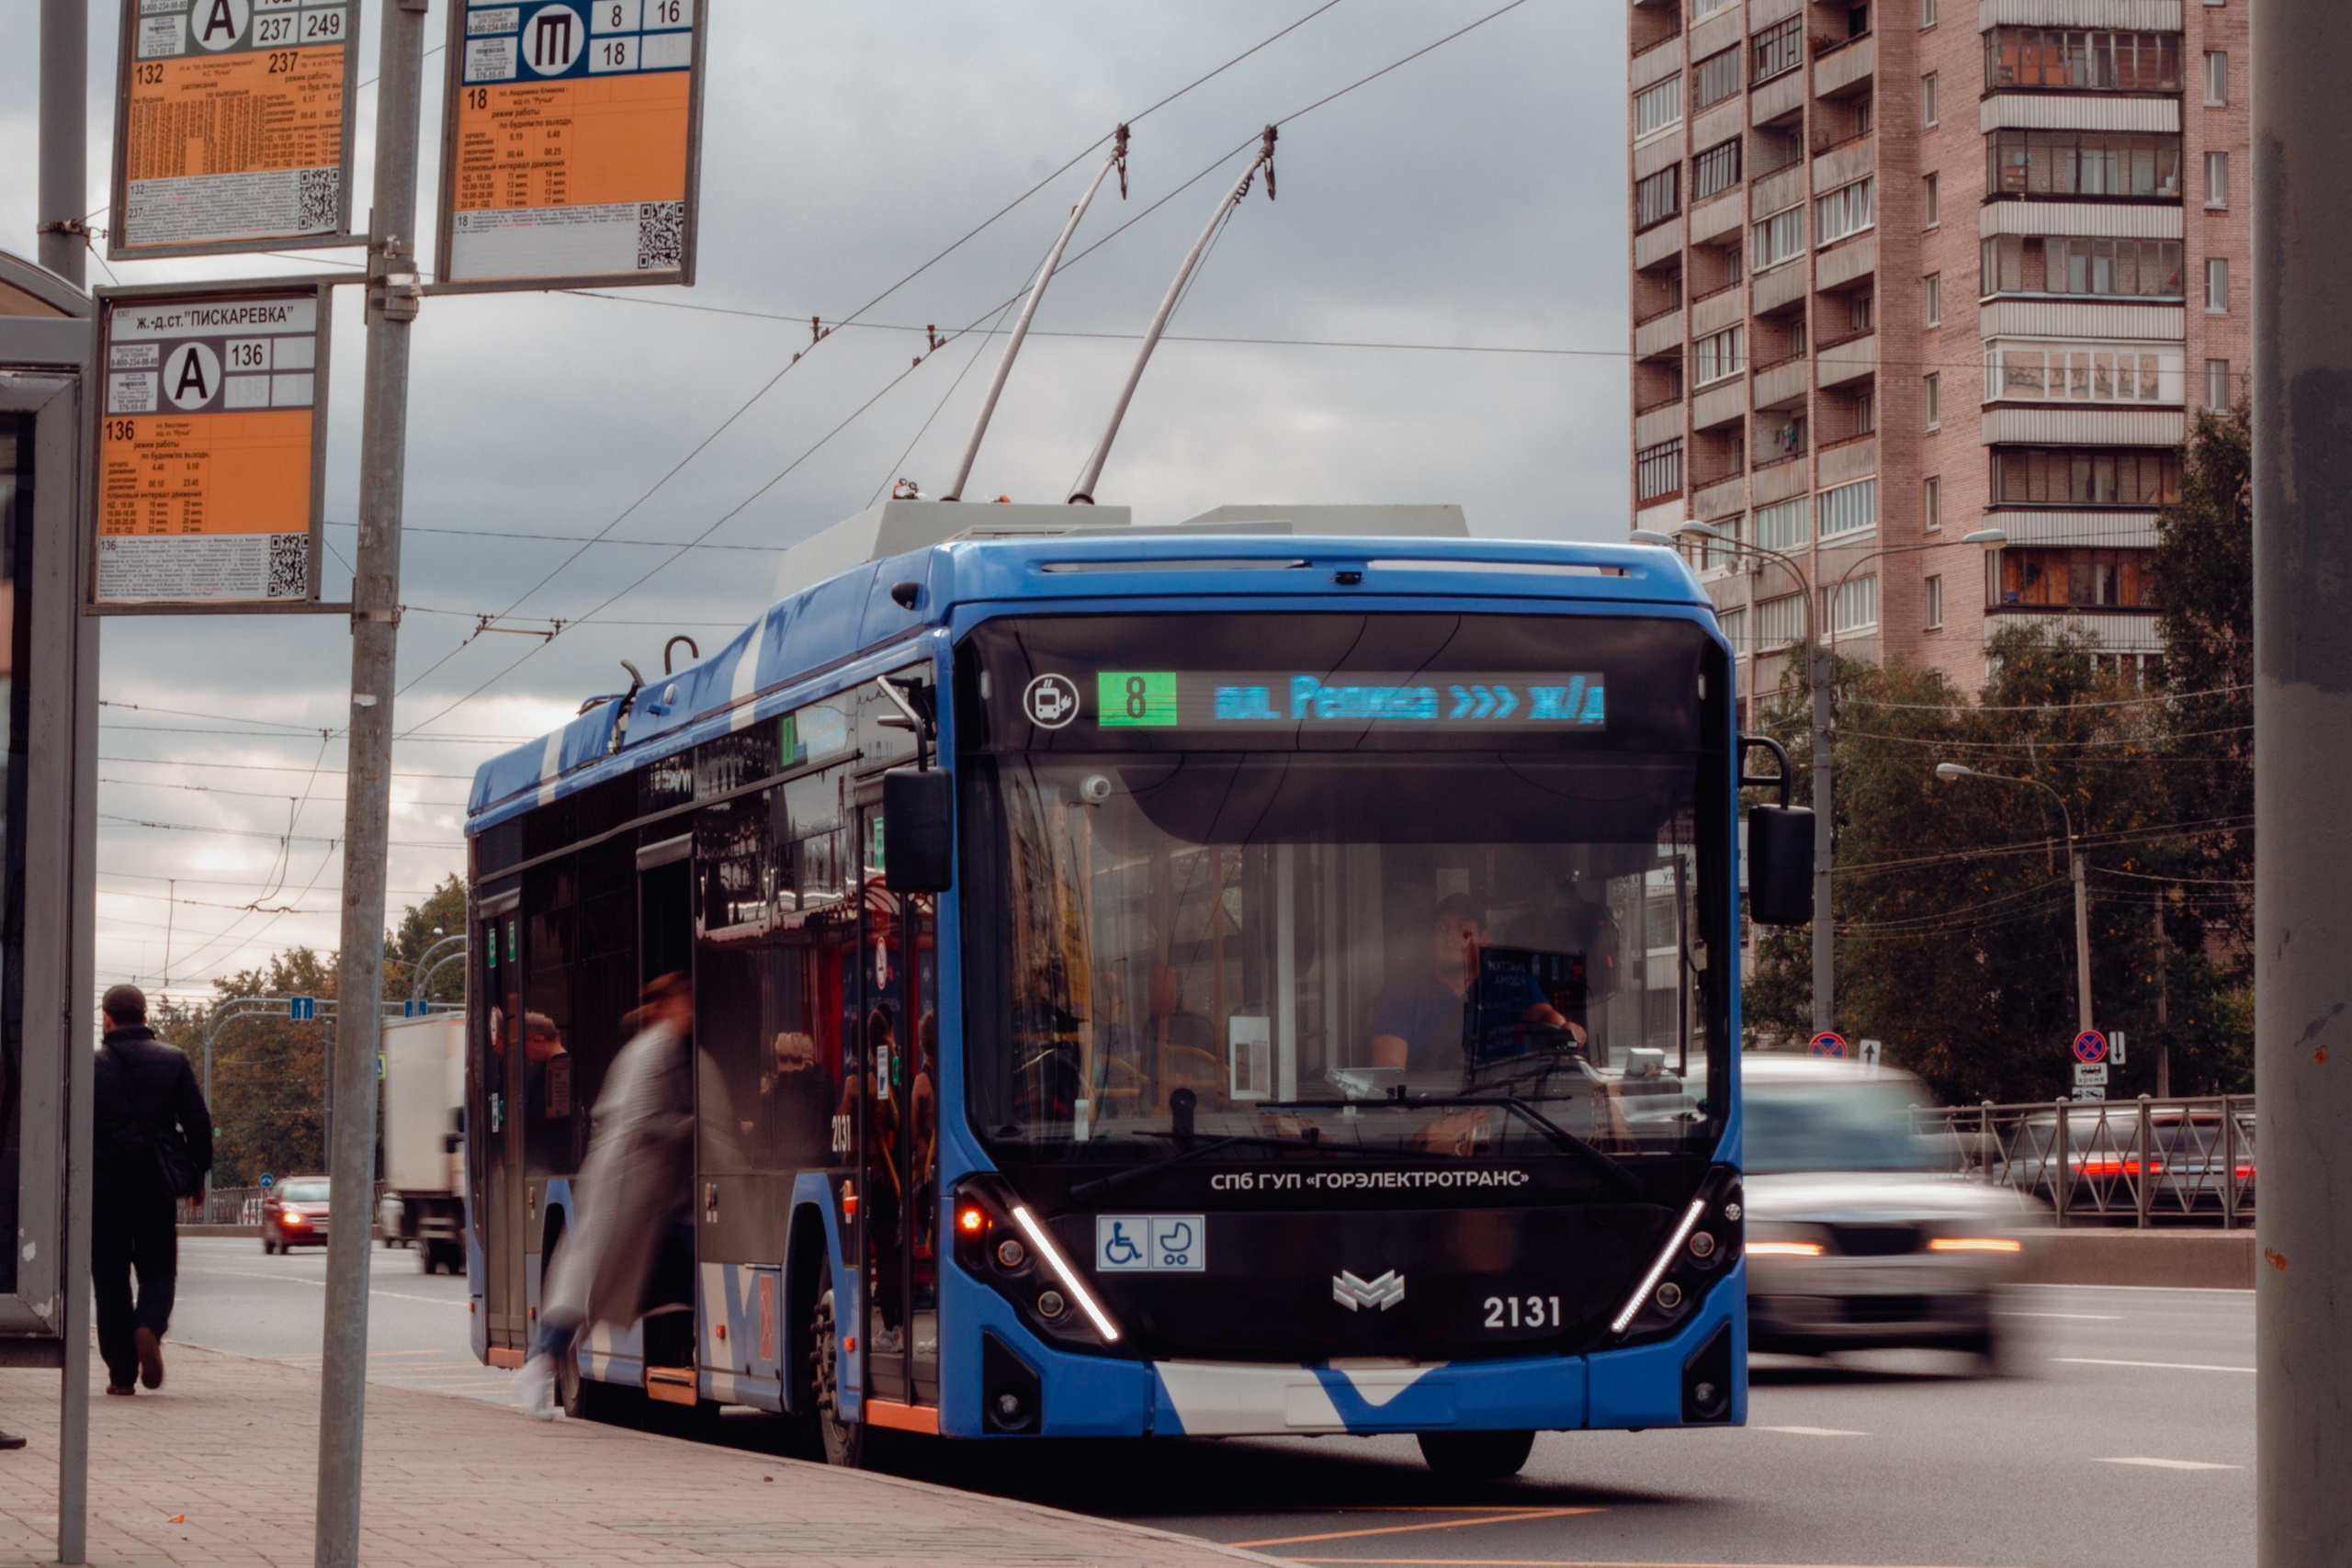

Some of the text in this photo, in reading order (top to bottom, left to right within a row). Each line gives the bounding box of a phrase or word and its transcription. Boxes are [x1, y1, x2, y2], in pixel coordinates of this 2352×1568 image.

[611, 0, 680, 28] 8 16
[260, 13, 339, 41] 237 249
[269, 52, 299, 73] 237
[603, 42, 625, 66] 18
[137, 63, 164, 85] 132
[285, 72, 331, 84] режим работы
[181, 82, 218, 91] расписание
[468, 88, 487, 110] 18
[492, 107, 540, 119] режим работы
[507, 148, 561, 158] 00.44 00.25
[462, 164, 496, 172] плановый
[531, 161, 565, 169] движения
[130, 184, 144, 195] 132
[129, 208, 143, 218] 237
[458, 215, 468, 226] 18
[232, 344, 262, 366] 136
[106, 420, 134, 441] 136
[156, 440, 179, 449] работы
[101, 540, 116, 551] 136
[1126, 676, 1146, 718] 8
[832, 1115, 850, 1152] 2131
[1260, 1174, 1301, 1189] ГУП
[1306, 1170, 1530, 1189] «ГОРЭЛЕКТРОТРАНС»
[1484, 1296, 1560, 1327] 2131
